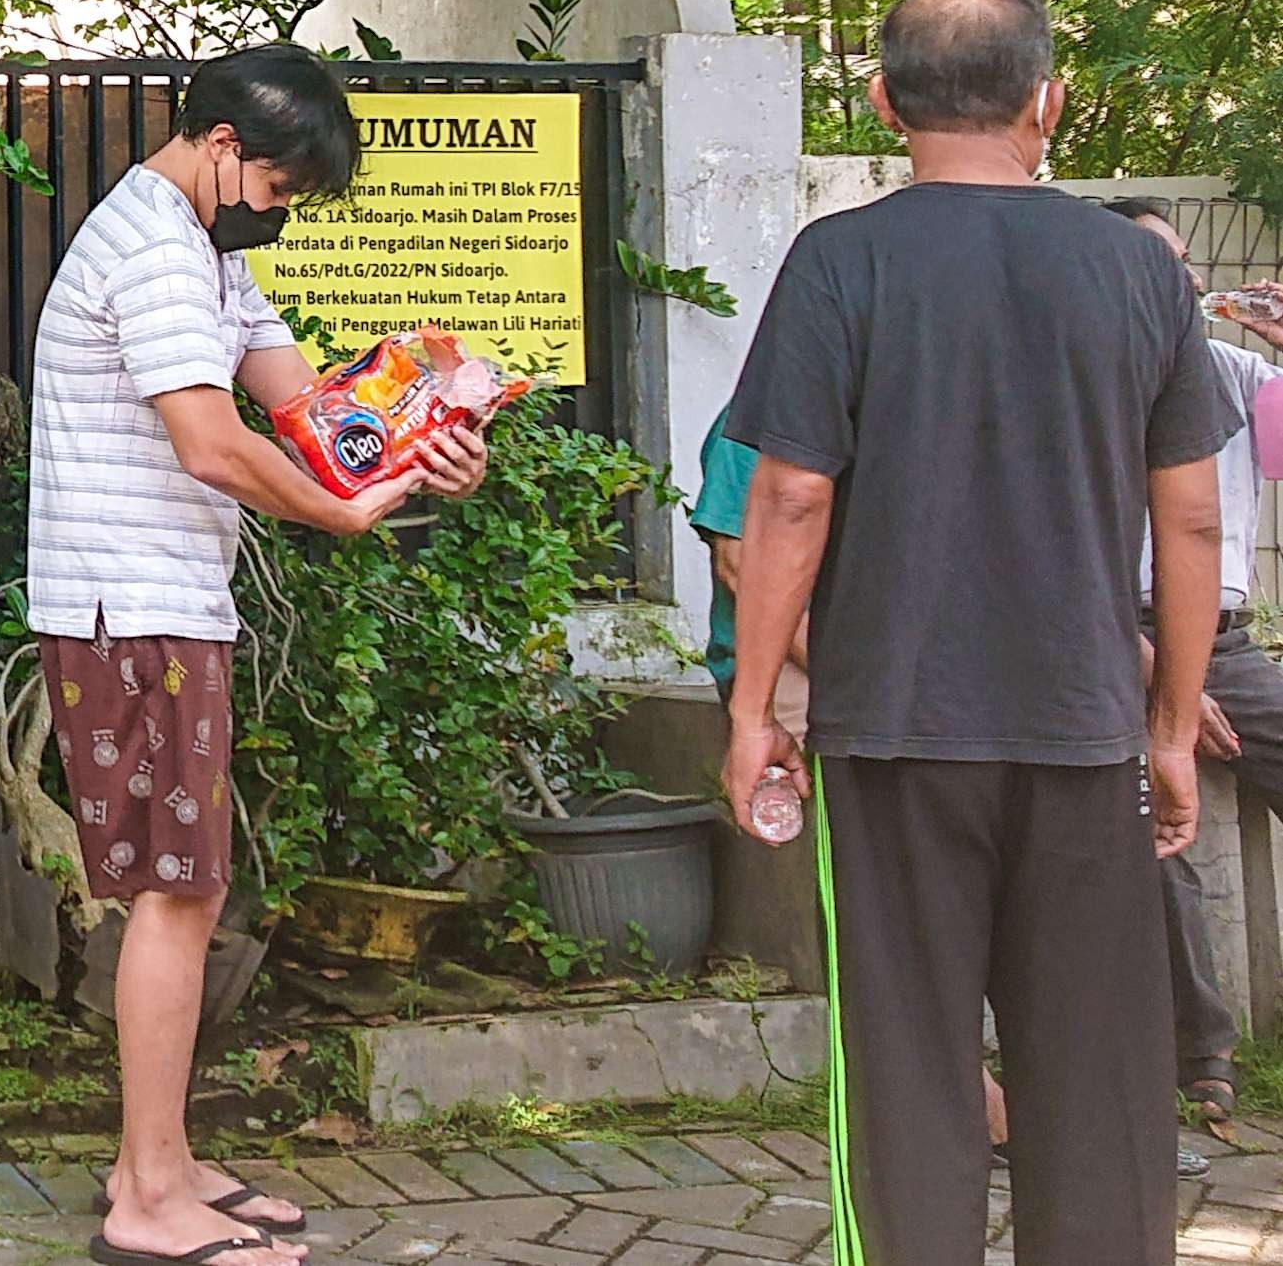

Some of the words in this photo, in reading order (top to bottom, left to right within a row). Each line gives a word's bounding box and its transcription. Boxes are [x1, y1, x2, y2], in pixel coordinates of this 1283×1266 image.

[355, 119, 536, 147] UMUMAN
[391, 182, 444, 195] Rumah
[449, 182, 467, 195] ini
[472, 182, 496, 195] TPI
[501, 181, 535, 195] Blok
[297, 210, 325, 222] No.
[327, 210, 346, 222] 1A
[351, 210, 418, 226] Sidoarjo.
[423, 210, 467, 223] Masih
[473, 210, 522, 223] Dalam
[528, 210, 577, 223] Proses
[277, 236, 334, 249] Perdata
[340, 236, 354, 249] di
[359, 236, 444, 252] Pengadilan
[450, 236, 501, 252] Negeri
[505, 236, 568, 252] Sidoarjo
[441, 263, 508, 279] Sidoarjo.
[264, 290, 301, 304] elum
[306, 290, 402, 304] Berkekuatan
[407, 290, 462, 304] Hukum
[466, 290, 510, 307] Tetap
[516, 290, 566, 304] Antara
[342, 317, 422, 334] Penggugat
[428, 317, 498, 330] Melawan
[503, 317, 526, 330] Lili
[531, 317, 581, 330] Hariati
[340, 434, 383, 468] Cleo
